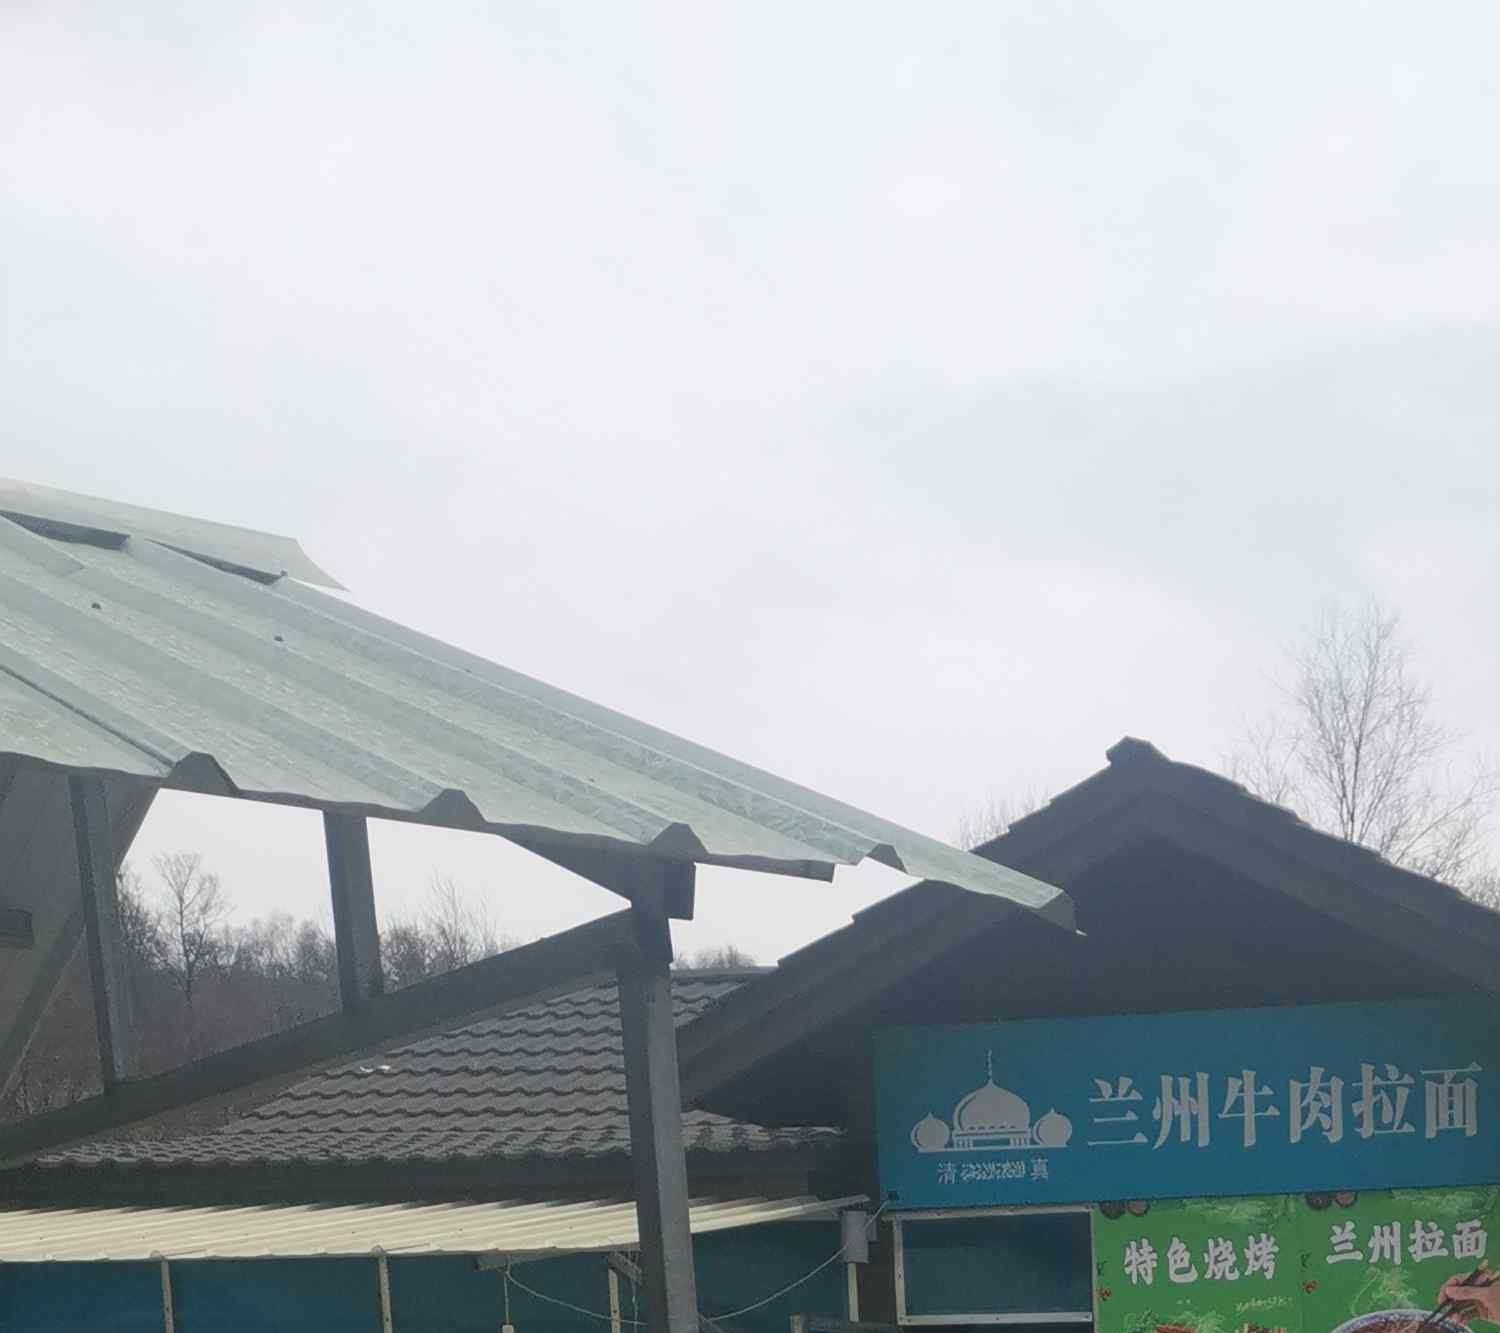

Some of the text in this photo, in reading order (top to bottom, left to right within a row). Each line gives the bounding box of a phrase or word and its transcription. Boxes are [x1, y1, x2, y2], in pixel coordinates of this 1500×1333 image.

[1087, 1061, 1484, 1149] 兰州牛肉拉面
[1124, 1233, 1279, 1286] 特色烧烤
[1326, 1219, 1488, 1266] 兰州拉面
